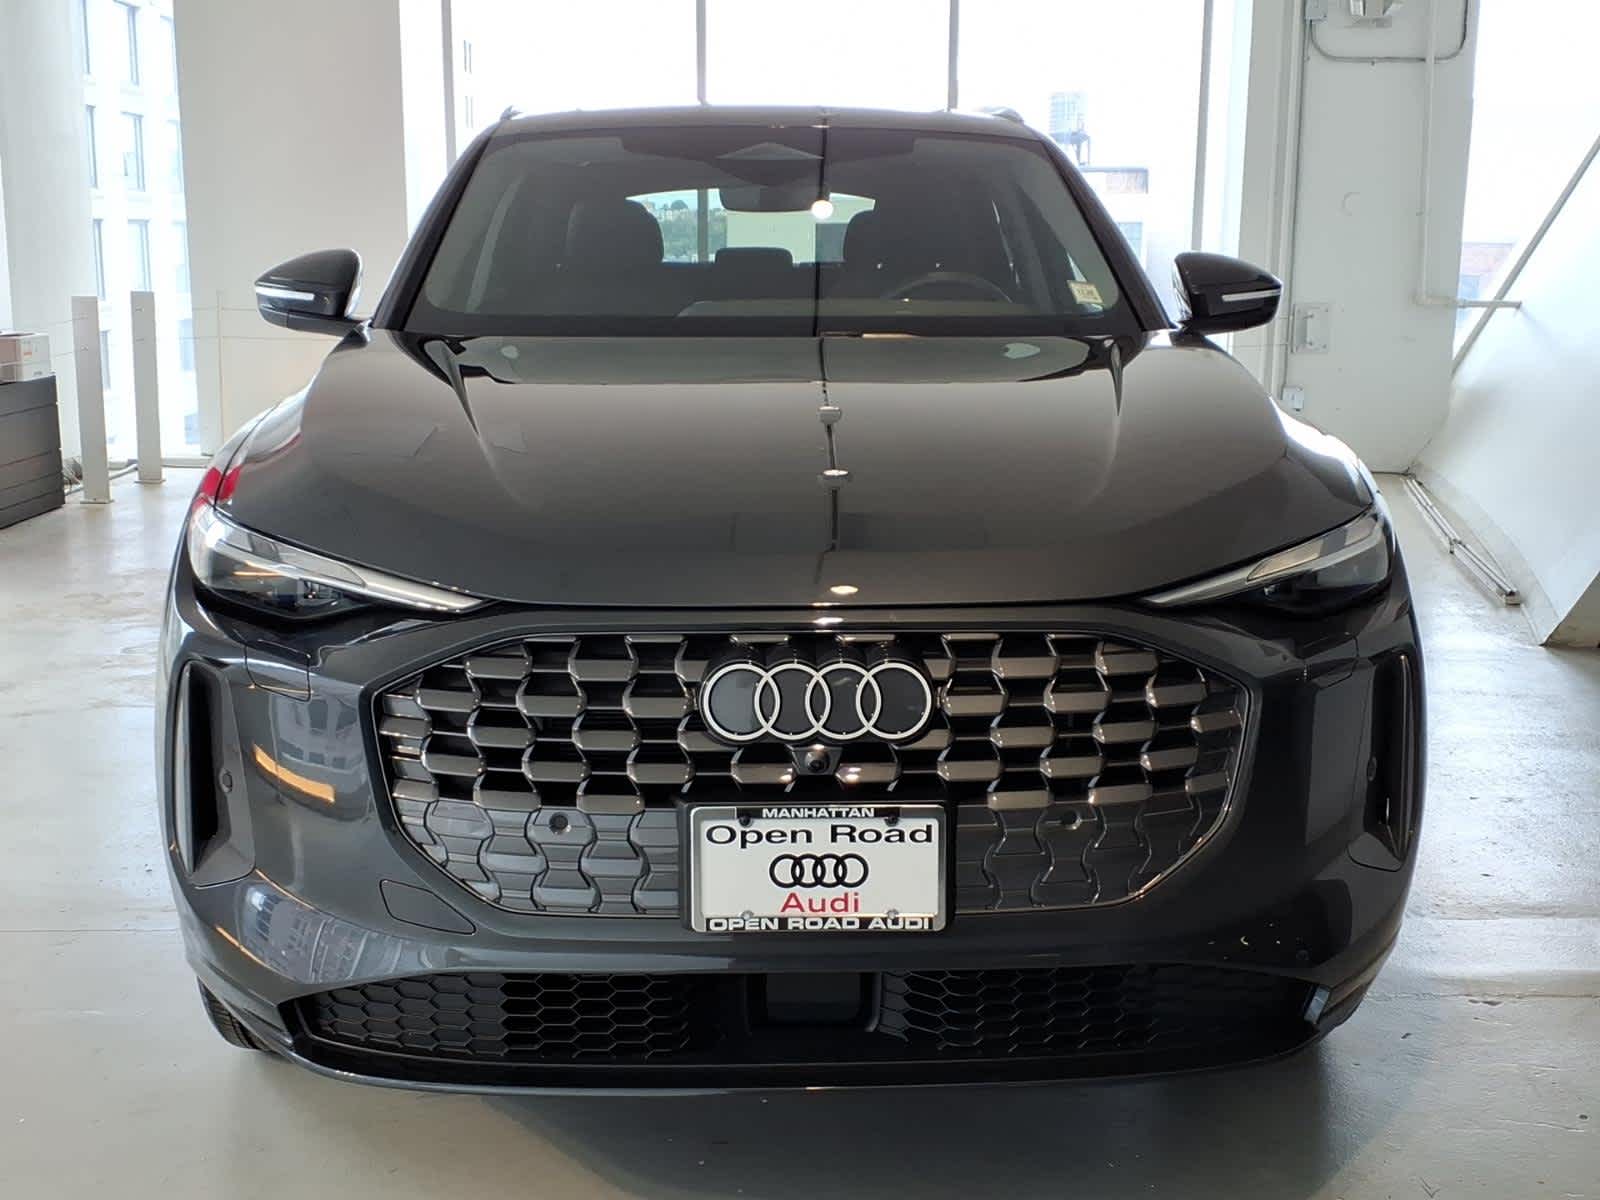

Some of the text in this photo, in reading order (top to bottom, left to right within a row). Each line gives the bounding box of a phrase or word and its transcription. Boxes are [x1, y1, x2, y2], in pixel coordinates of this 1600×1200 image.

[762, 807, 875, 818] MANHATTAN
[705, 824, 933, 849] Open Road
[780, 892, 860, 913] Audi
[709, 917, 929, 931] OPEN ROAD AUDI
